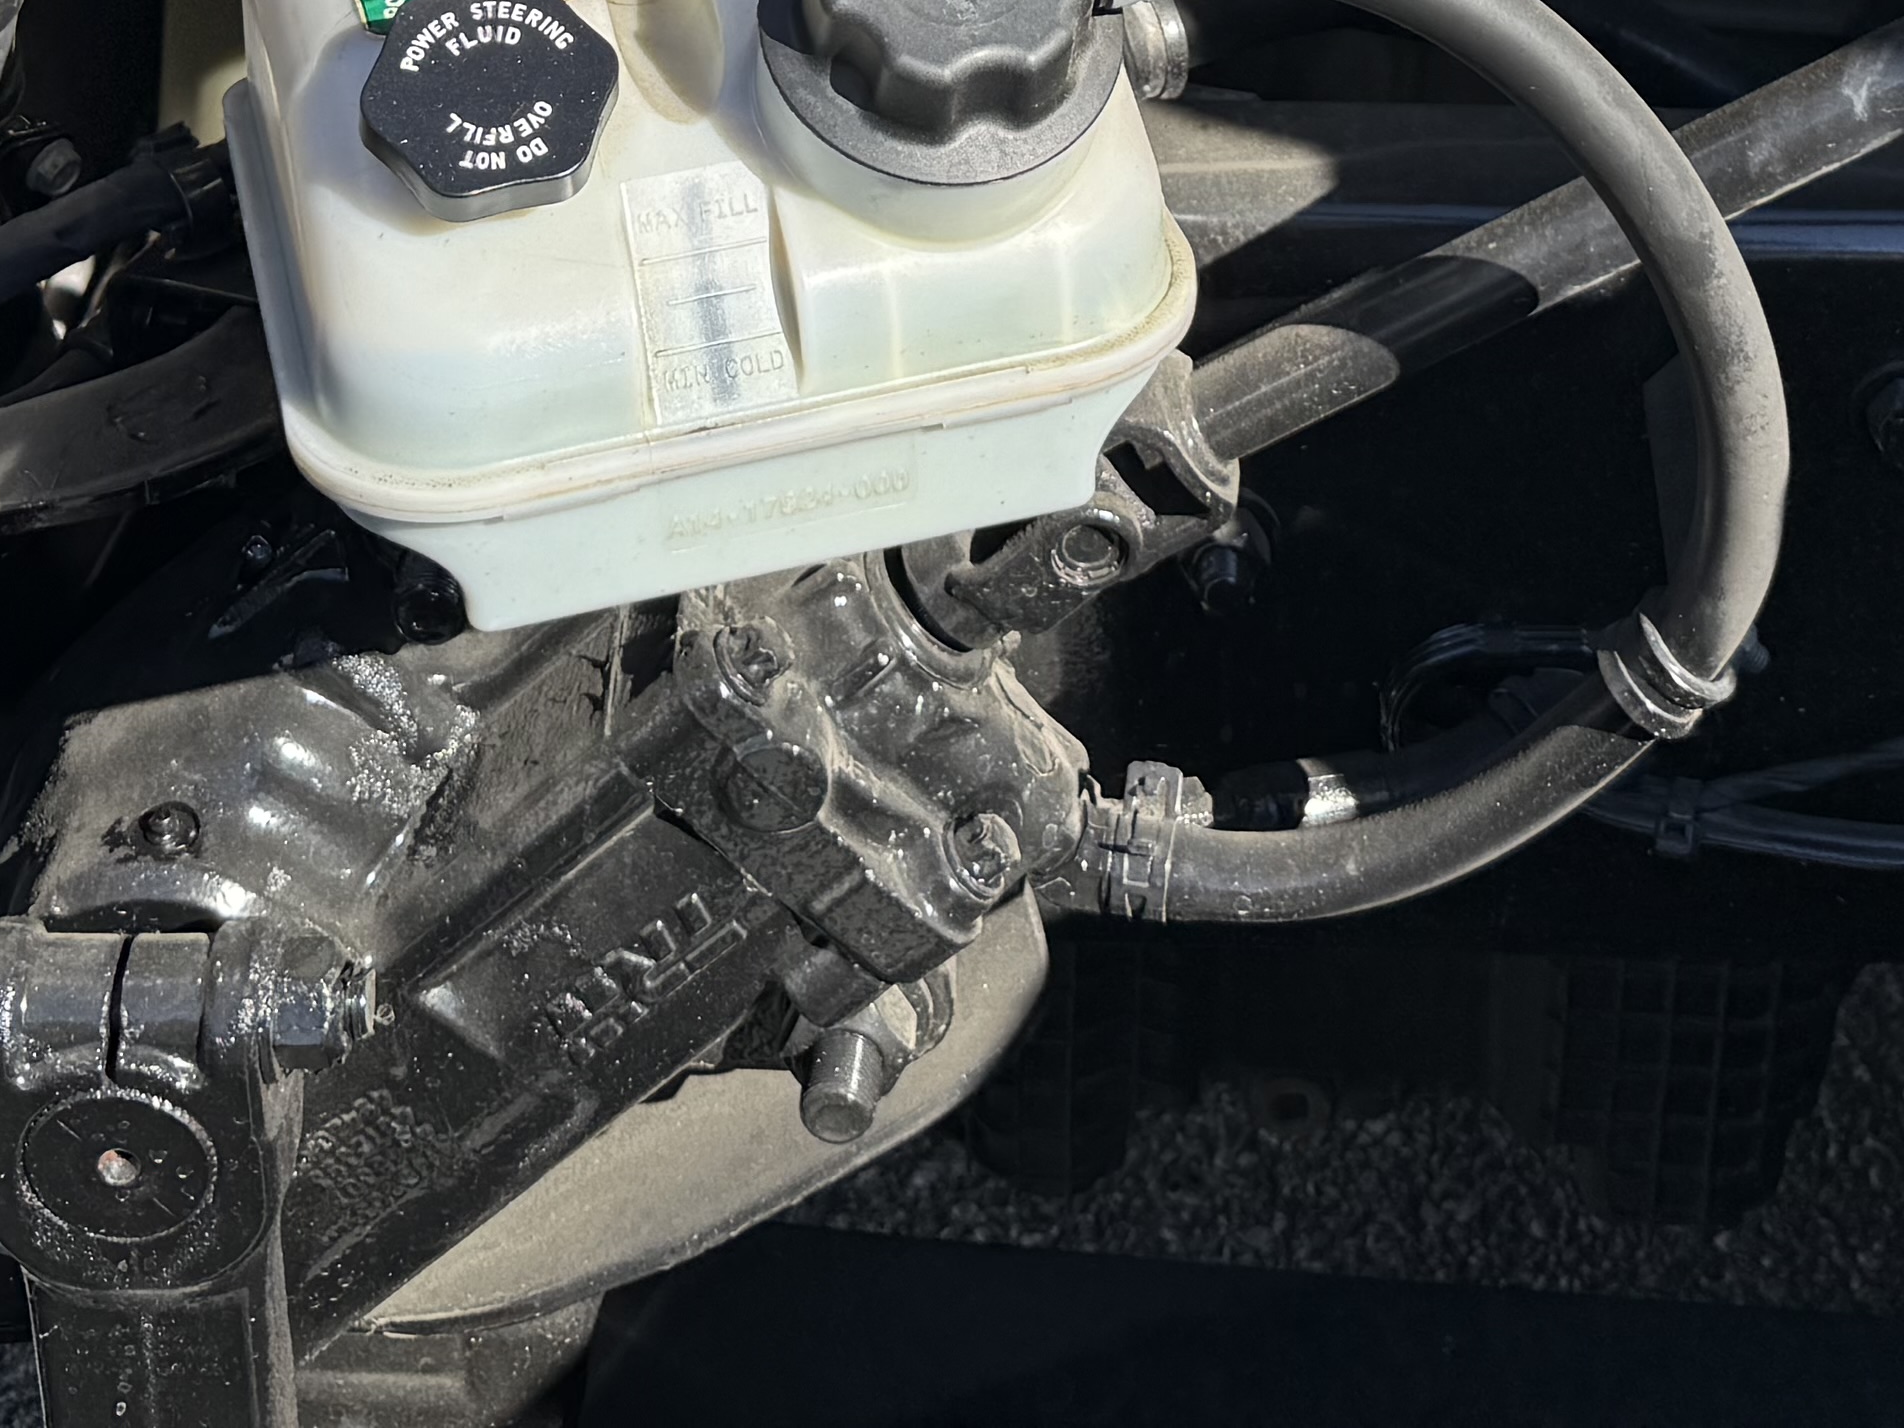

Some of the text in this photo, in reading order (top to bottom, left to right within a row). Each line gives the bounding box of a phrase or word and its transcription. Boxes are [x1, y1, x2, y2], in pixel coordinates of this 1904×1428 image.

[399, 0, 575, 73] POWER STEERING
[445, 25, 522, 57] FLUID
[445, 100, 554, 146] OVERFILL
[458, 136, 549, 170] DO NOT
[636, 192, 759, 235] MAX FILL
[663, 349, 785, 393] MIN COLD
